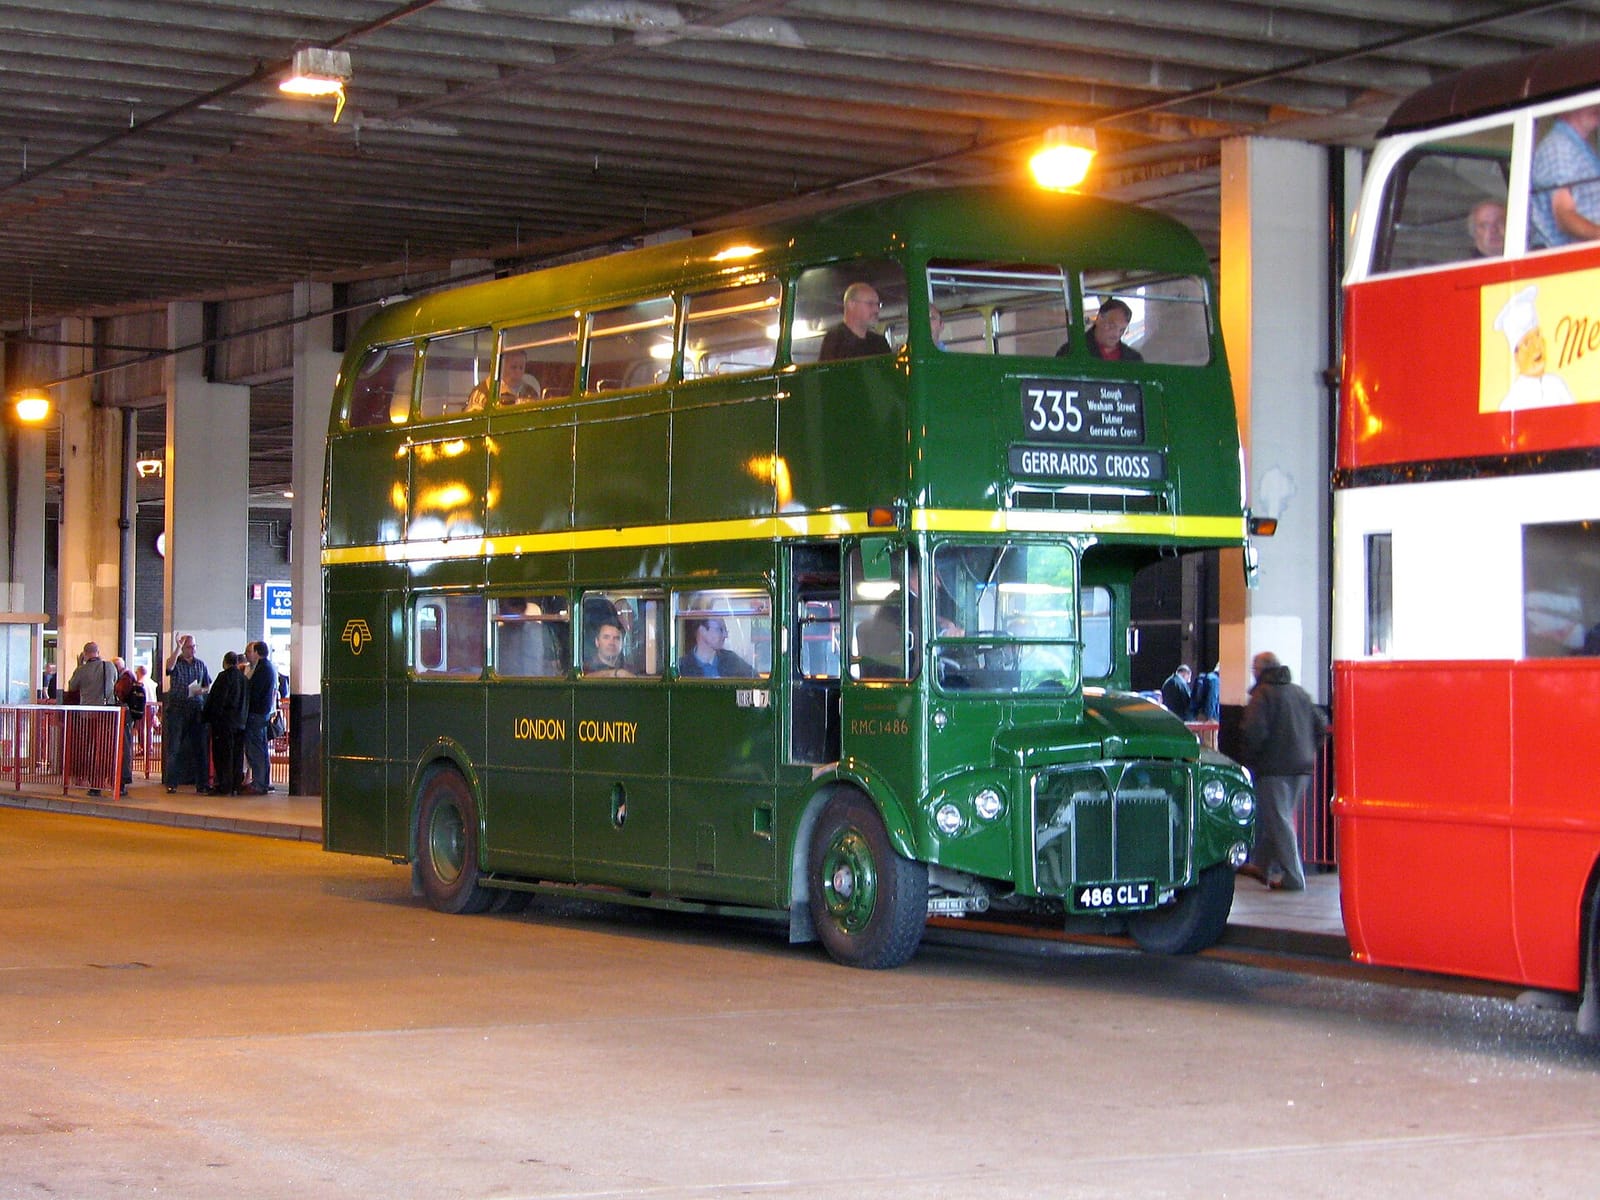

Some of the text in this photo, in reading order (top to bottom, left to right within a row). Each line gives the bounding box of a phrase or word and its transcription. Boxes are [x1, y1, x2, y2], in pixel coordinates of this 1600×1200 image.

[1100, 388, 1122, 400] Slough
[1028, 389, 1083, 432] 335
[1087, 400, 1136, 413] Wexham Street
[1089, 425, 1138, 438] Gerrards Cross
[1022, 451, 1150, 478] GERRARDS CROSS
[514, 717, 638, 744] LONDON COUNTRY
[1080, 884, 1149, 907] 486 CLT
